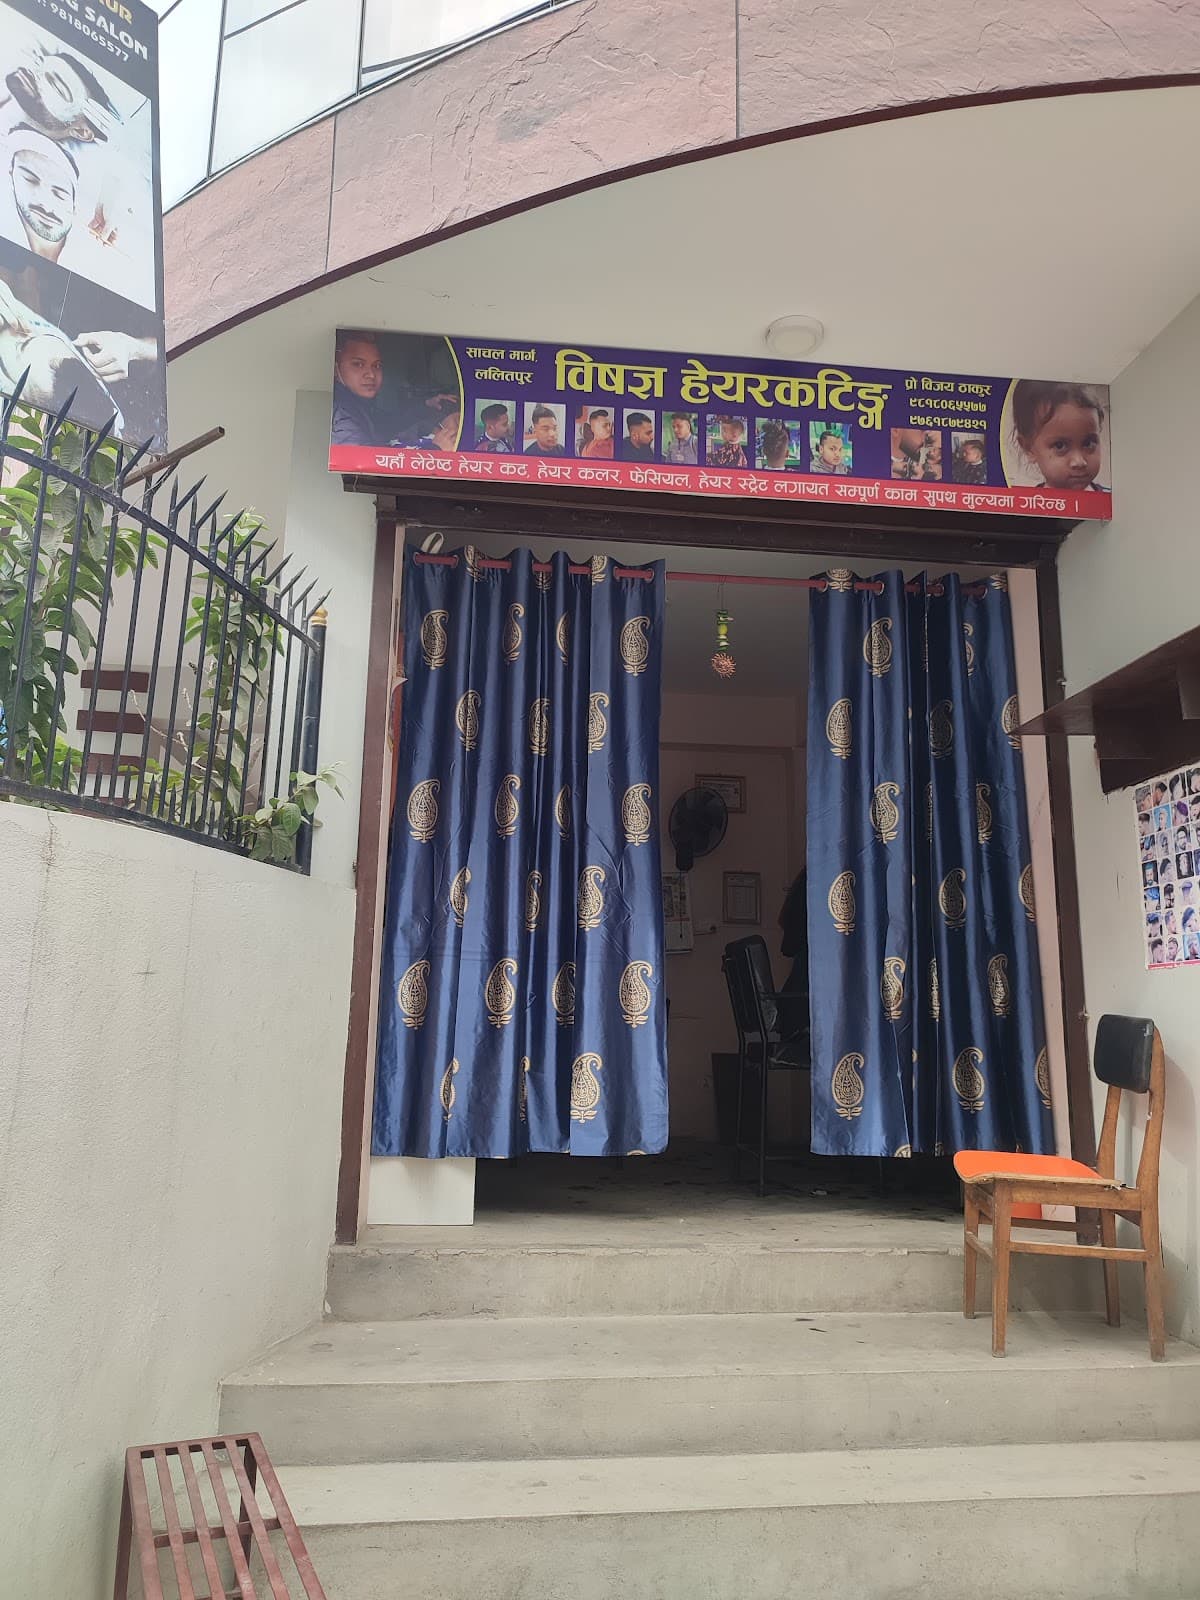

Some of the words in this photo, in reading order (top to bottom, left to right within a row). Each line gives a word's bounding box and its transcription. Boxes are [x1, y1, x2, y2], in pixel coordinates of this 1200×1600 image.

[50, 2, 129, 61] 9818065577
[84, 6, 148, 61] SALON
[474, 366, 534, 385] ललितपुर
[555, 348, 668, 400] विषज्ञ
[680, 358, 893, 430] हेयरकटिङ्ग
[905, 376, 918, 391] प्रो
[921, 377, 955, 392] विजय
[958, 383, 992, 397] ठाकुर
[909, 397, 987, 412] ९८१८०६५५७७
[375, 452, 405, 470] यहाँ
[458, 455, 494, 474] हेयर
[537, 460, 573, 480] हेयर
[698, 470, 733, 490] हेयर
[774, 480, 829, 496] लगायत
[835, 482, 880, 502] सम्पूर्ण
[883, 487, 918, 502] काम
[922, 489, 957, 507] सुपथ
[961, 492, 1014, 509] मुल्यमा
[1019, 494, 1066, 511] गरिन्छ
